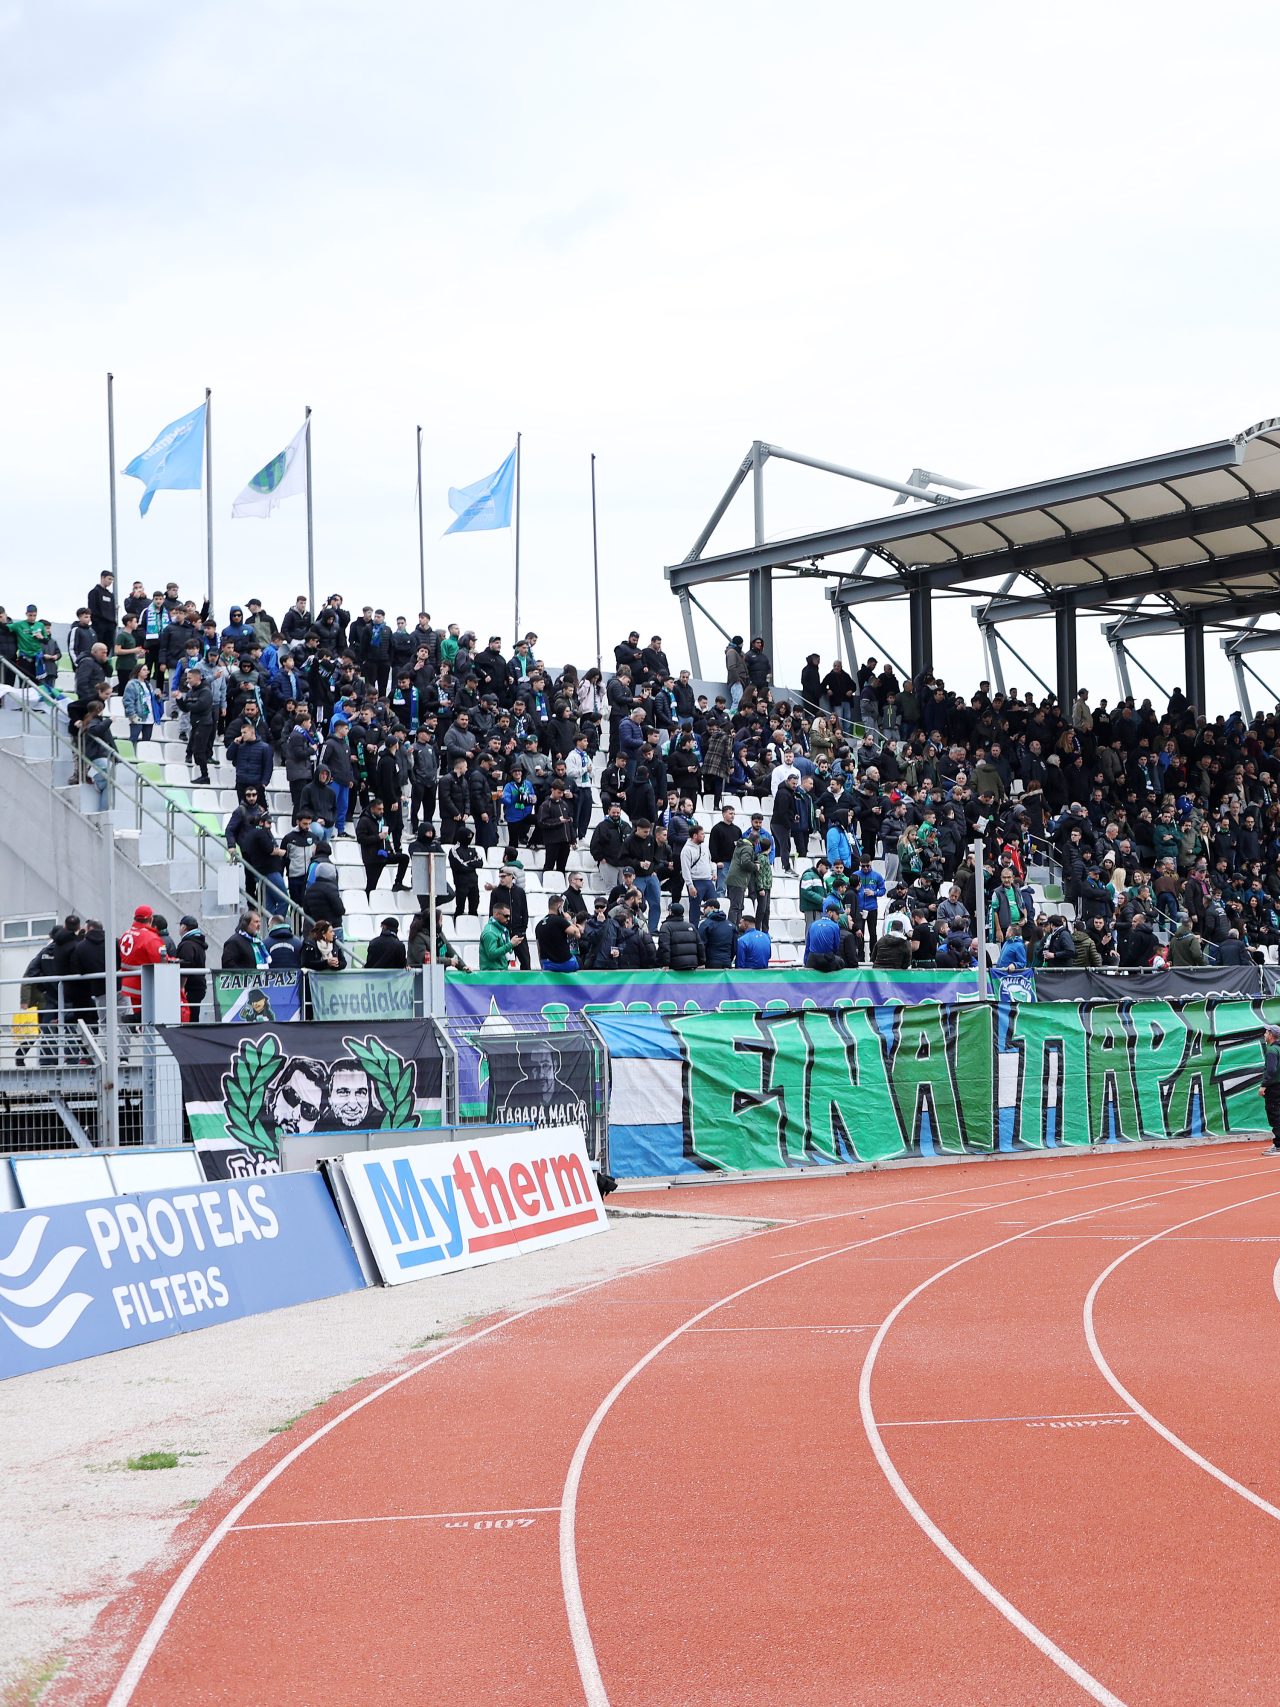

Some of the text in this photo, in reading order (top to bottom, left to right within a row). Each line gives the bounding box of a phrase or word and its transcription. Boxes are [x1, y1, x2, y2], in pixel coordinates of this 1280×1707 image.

[219, 970, 298, 990] ΖΑΓΑΡΑΣ
[85, 1184, 280, 1270] PROTEAS
[363, 1150, 594, 1258] Mytherm
[112, 1266, 230, 1330] FILTERS
[444, 1518, 537, 1530] 400 m
